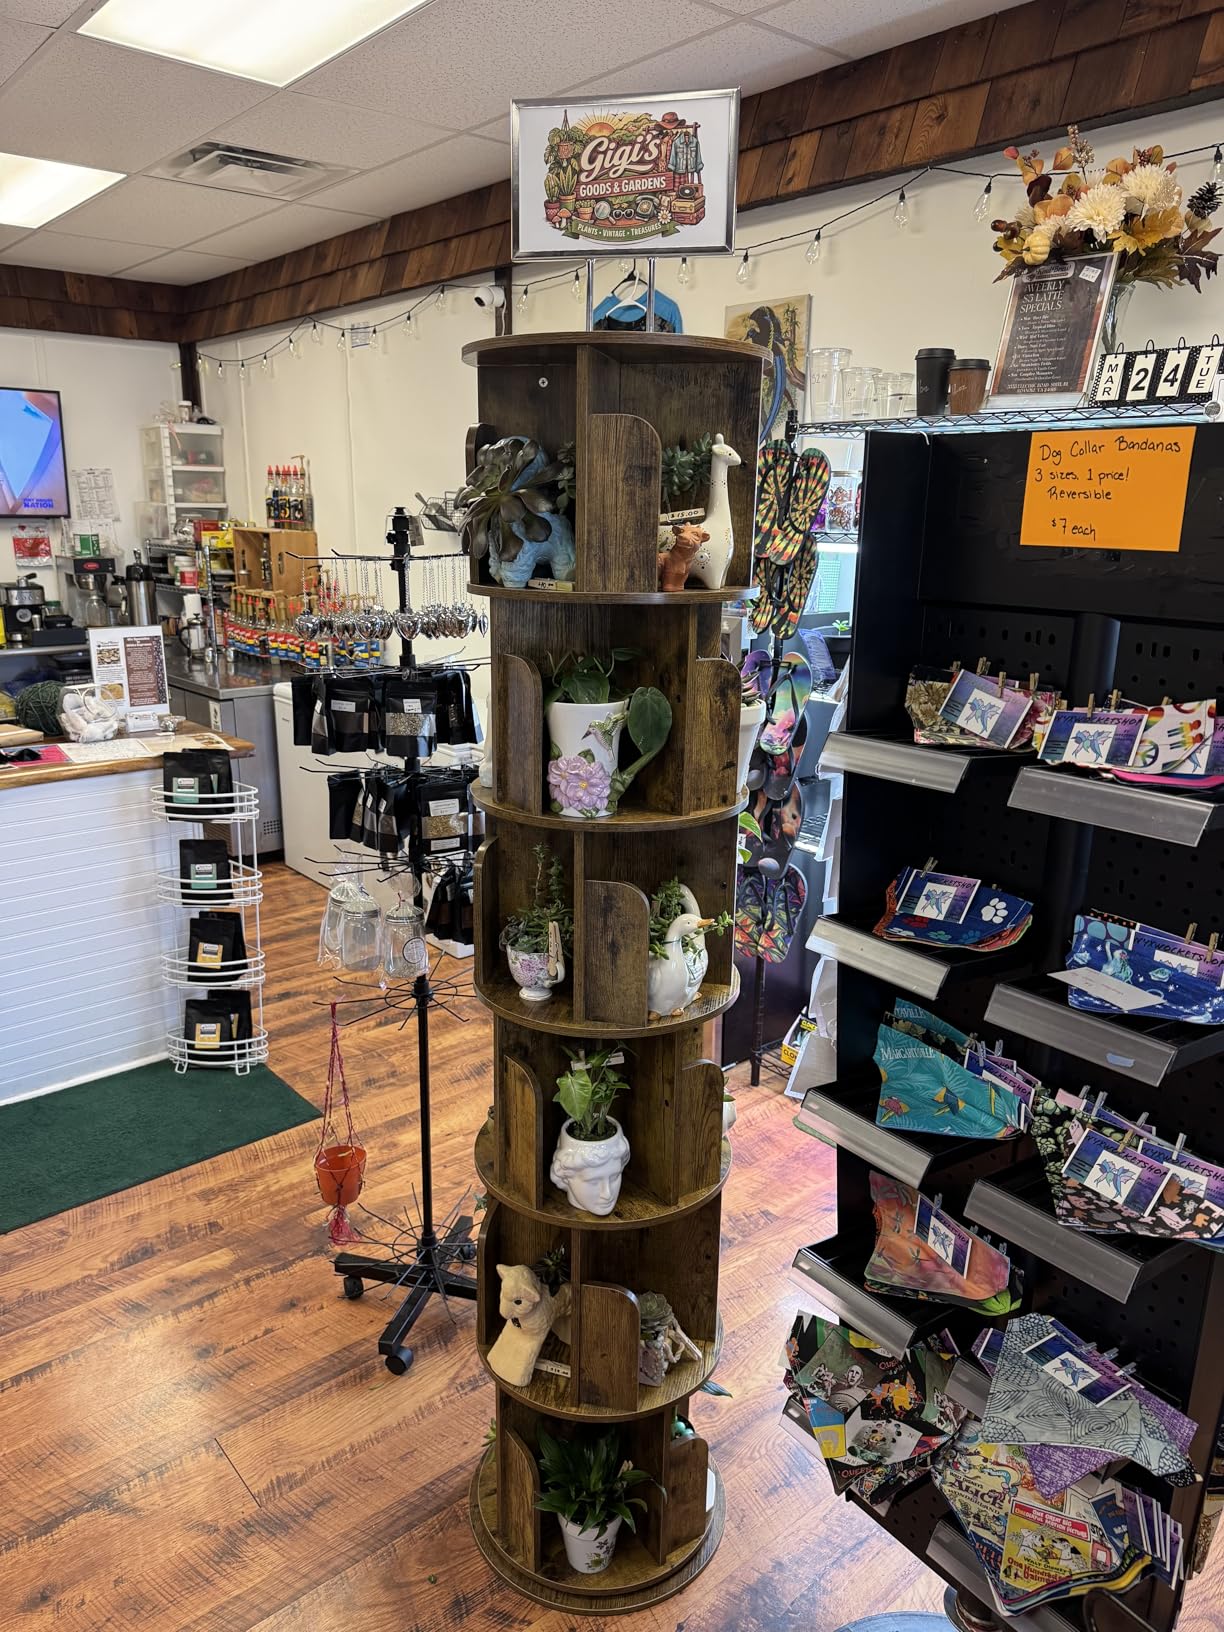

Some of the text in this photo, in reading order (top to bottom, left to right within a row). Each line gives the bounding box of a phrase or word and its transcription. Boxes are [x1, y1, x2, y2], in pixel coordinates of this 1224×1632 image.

[580, 134, 661, 183] Gigi's
[580, 176, 667, 198] GOODS & GARDENS
[577, 223, 662, 238] PLANTS VINTAGE TREASURES
[1034, 290, 1065, 303] LATTE
[1102, 363, 1119, 396] MAR
[1196, 355, 1214, 389] TUE
[1039, 435, 1181, 465] Dog Collar Bandanas
[1034, 468, 1043, 482] 3
[1087, 468, 1094, 481] 1
[1098, 466, 1130, 486] price!
[1047, 486, 1112, 500] Reversible
[1071, 524, 1096, 541] each
[948, 1478, 1006, 1510] ALICE
